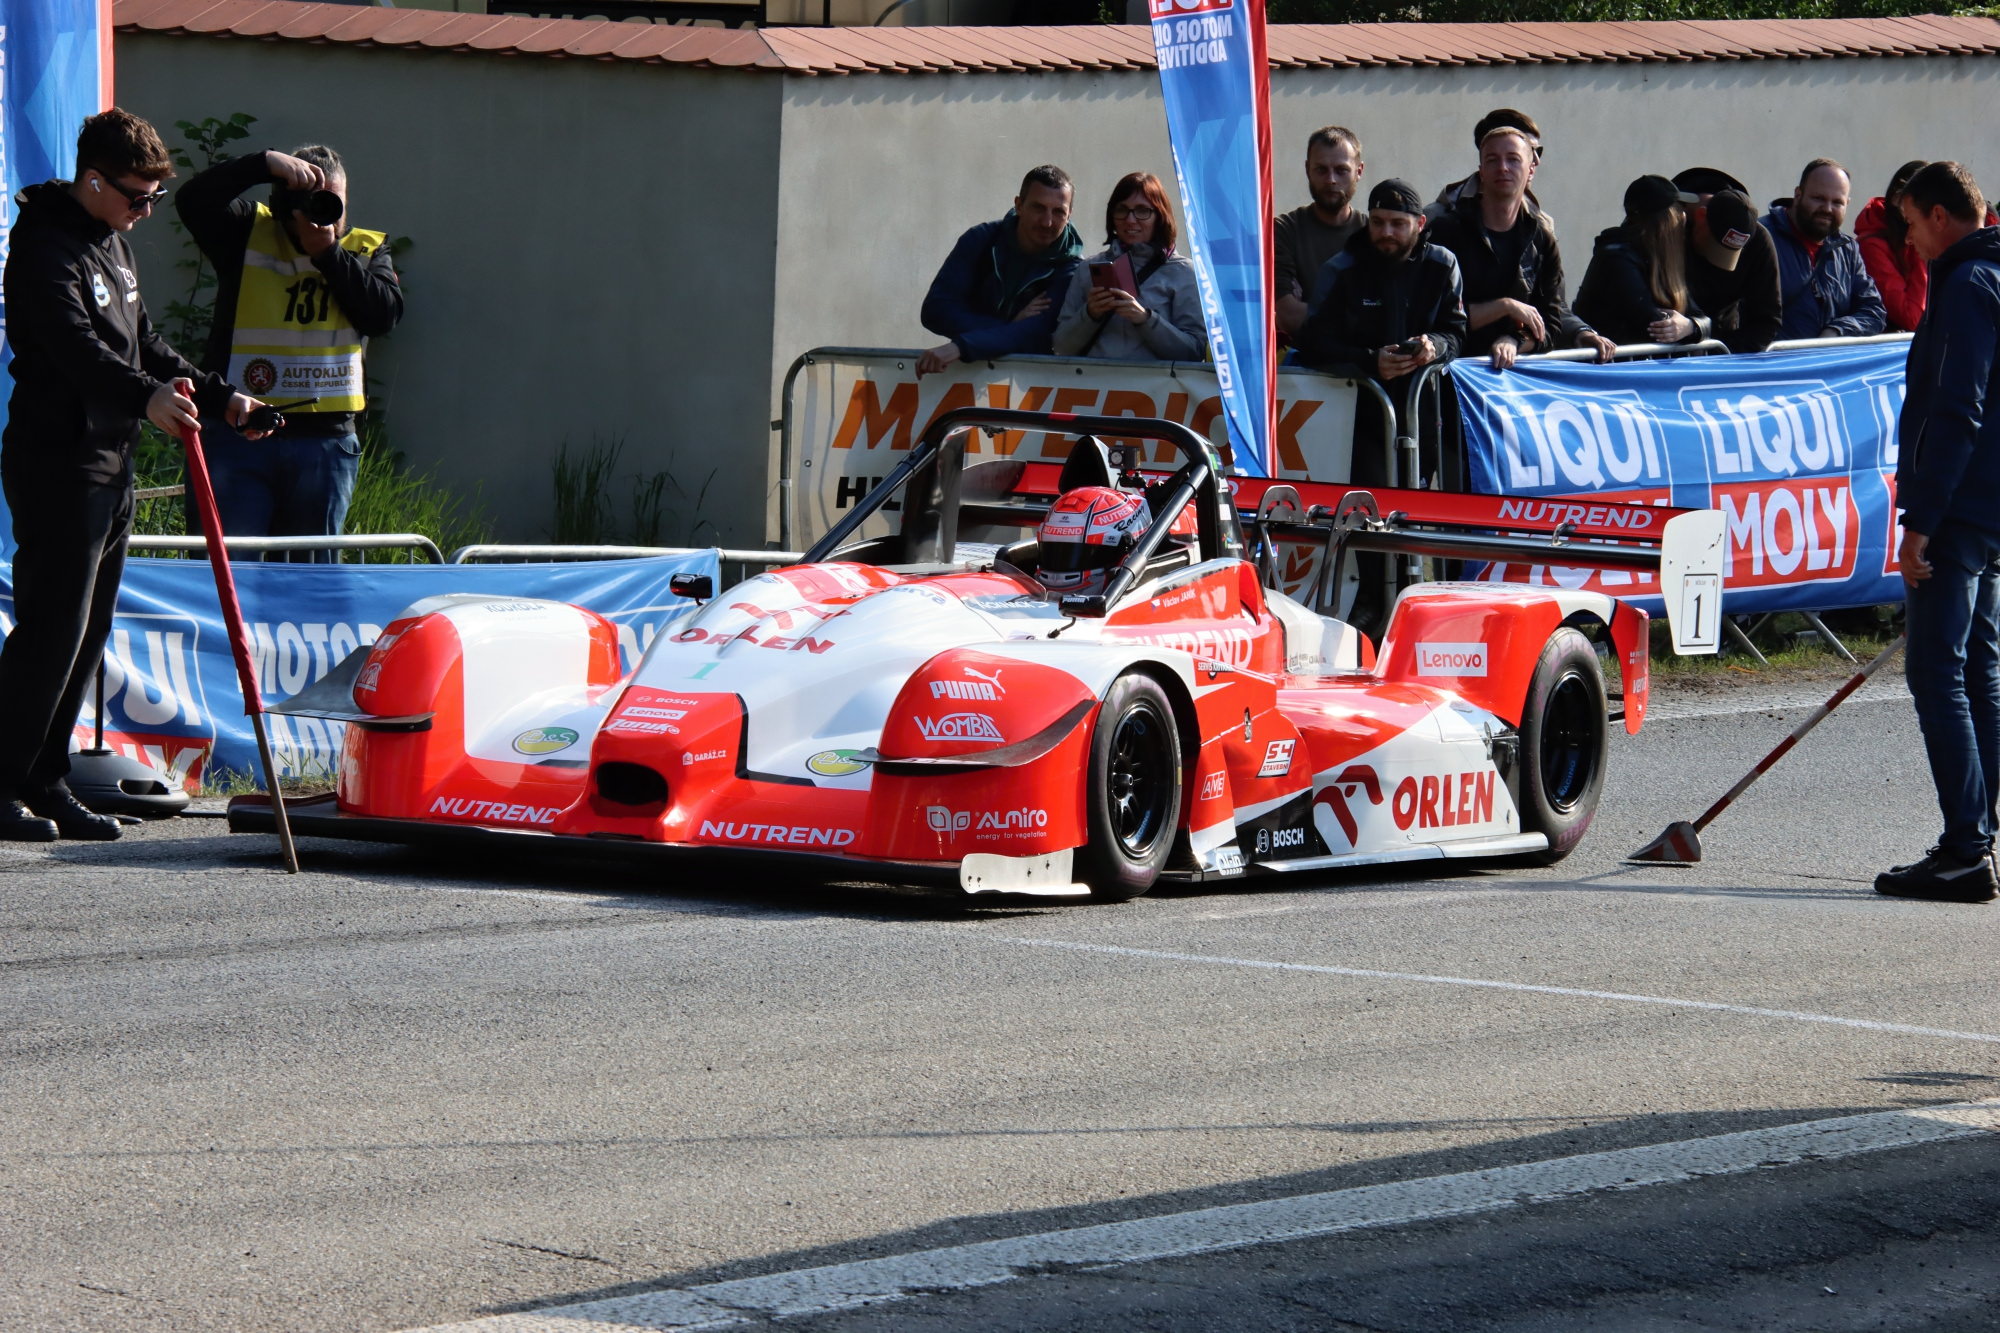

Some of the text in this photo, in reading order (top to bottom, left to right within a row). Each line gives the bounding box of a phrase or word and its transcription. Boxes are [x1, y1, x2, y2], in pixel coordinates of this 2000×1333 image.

[282, 366, 355, 379] AUTOKLUB
[1500, 400, 1662, 489] LIQUI
[1691, 392, 1845, 477] LIQUI
[1497, 499, 1653, 529] NUTREND
[1719, 486, 1848, 577] MOLY
[1692, 594, 1702, 639] 1
[669, 625, 836, 654] ORLEN
[1422, 649, 1482, 668] Lenovo
[655, 697, 699, 706] BOSCH
[929, 680, 997, 701] PUMA
[628, 708, 680, 718] Lenovo
[429, 797, 561, 824] NUTREND
[1392, 771, 1495, 830] ORLEN
[699, 819, 855, 846] NUTREND
[1273, 828, 1304, 847] BOSCH
